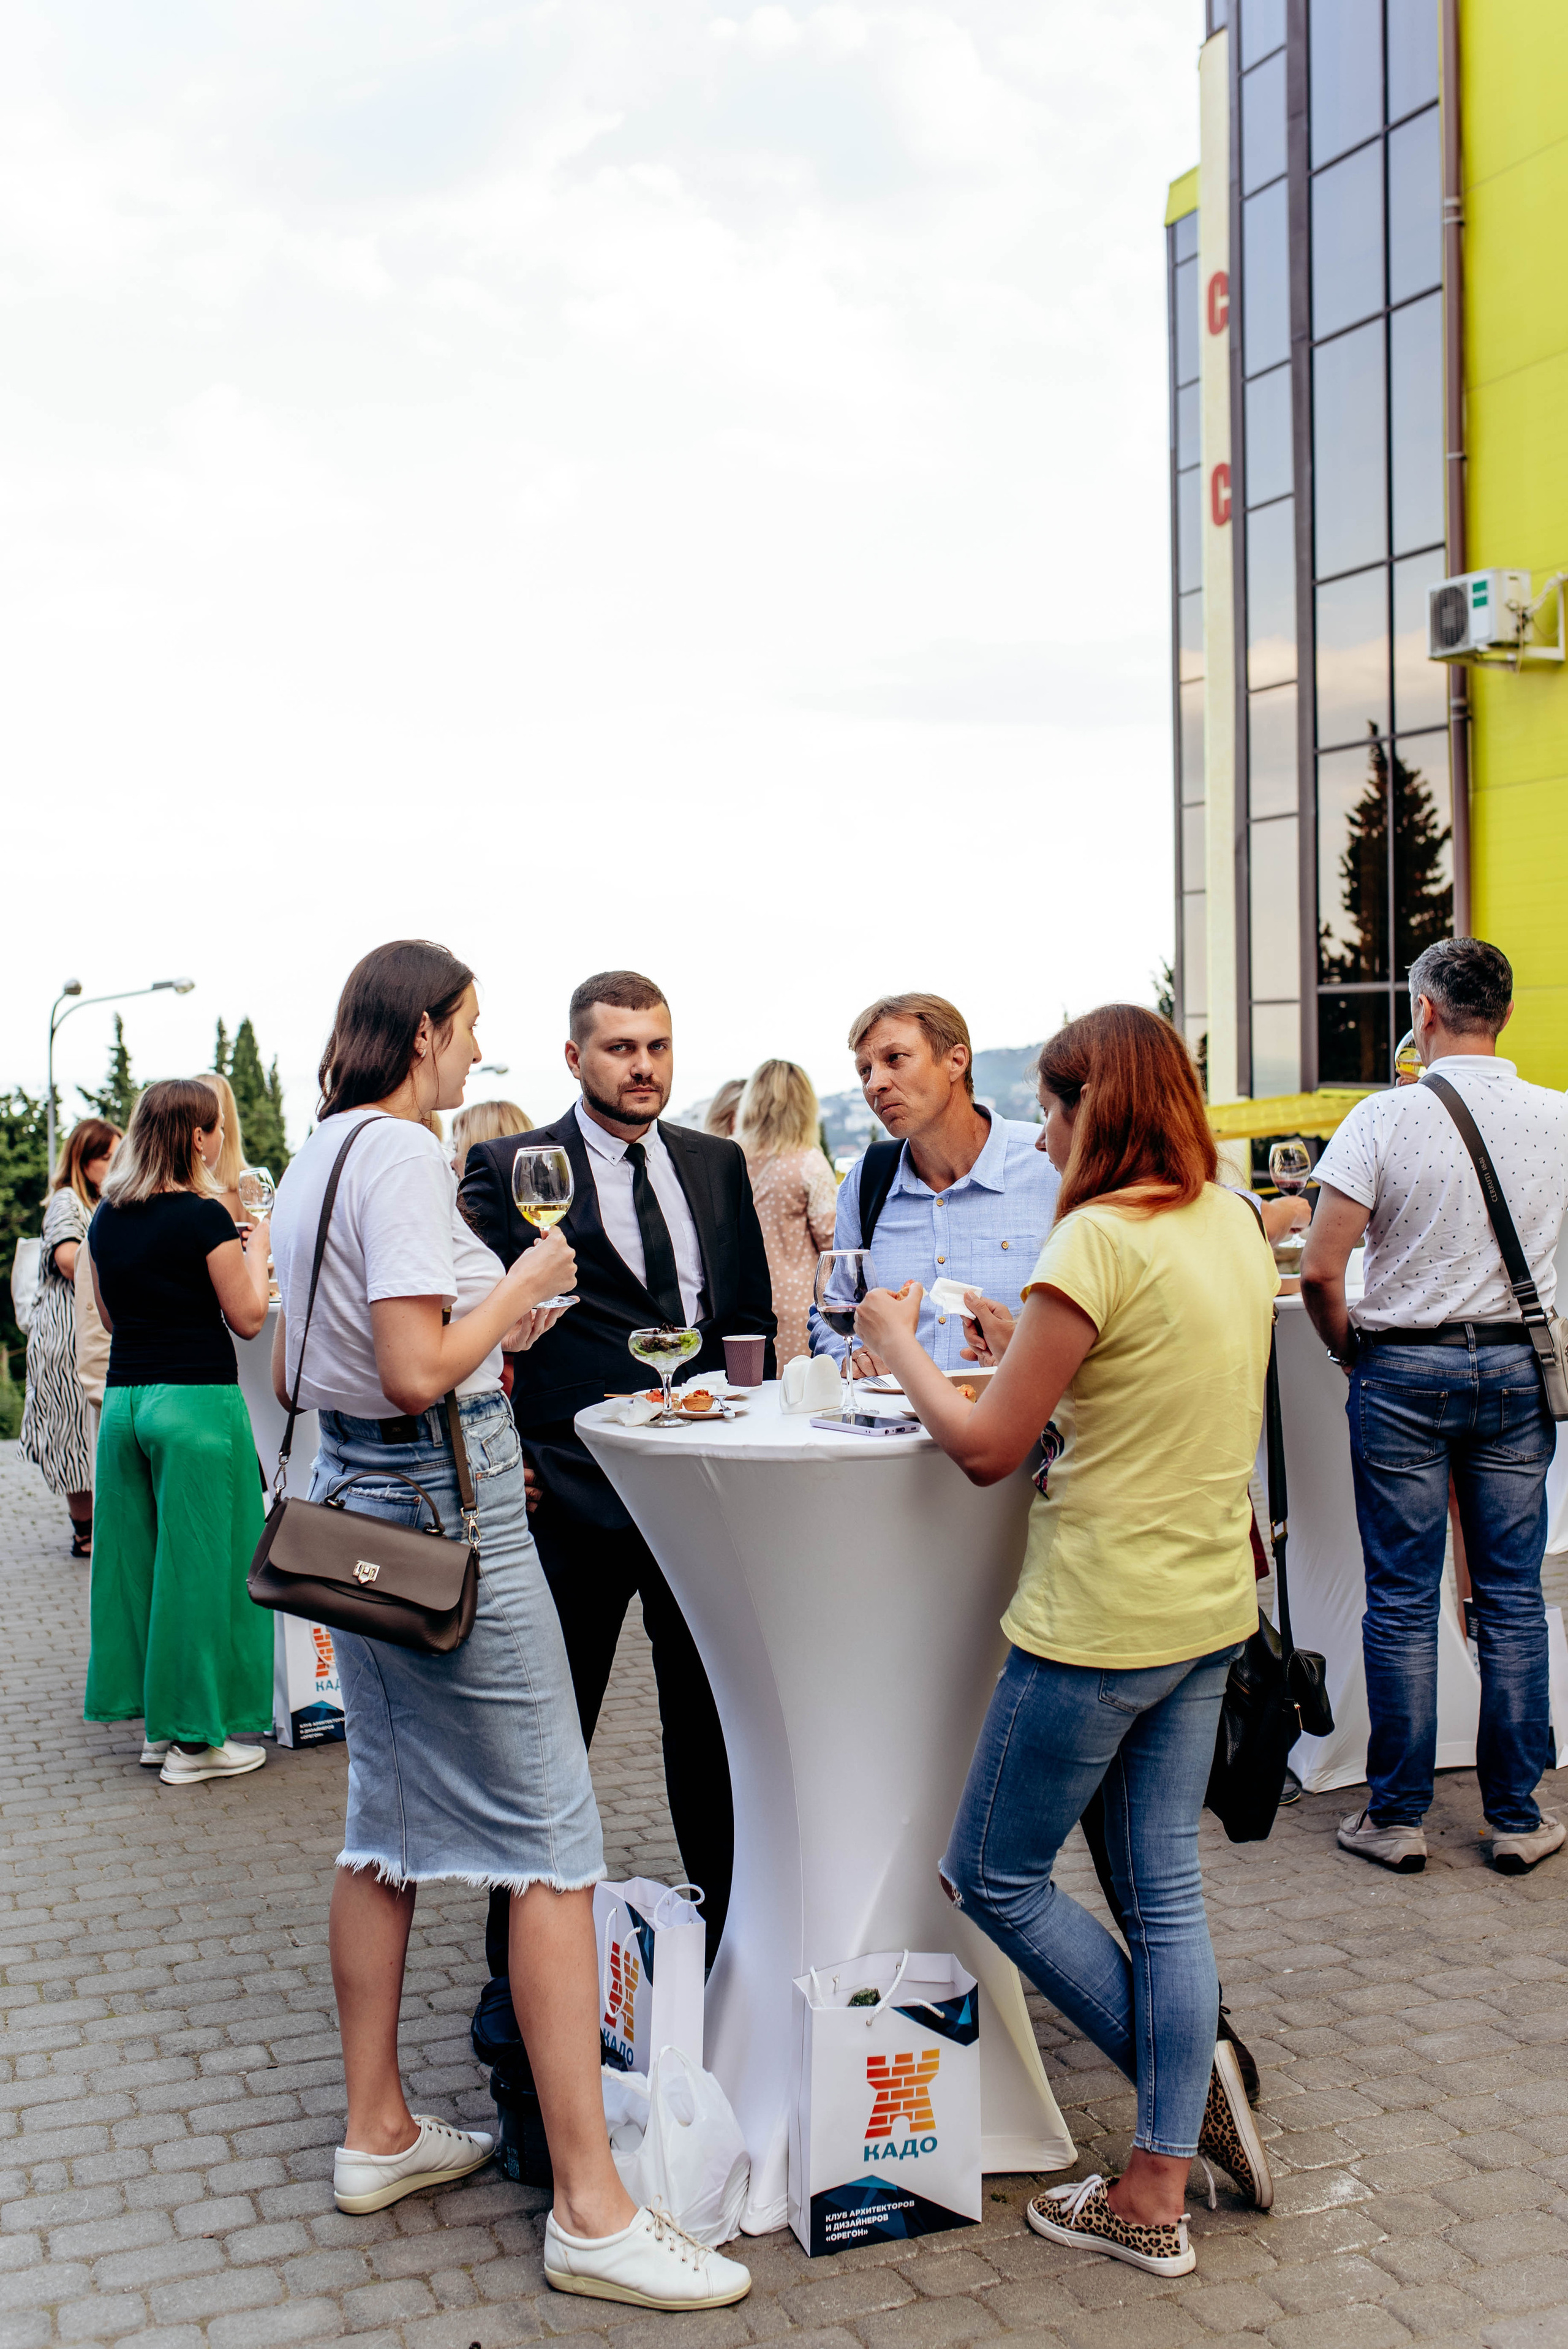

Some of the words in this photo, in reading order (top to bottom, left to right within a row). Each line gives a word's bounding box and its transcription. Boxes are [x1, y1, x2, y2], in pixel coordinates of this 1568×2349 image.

[1484, 1172, 1498, 1203] CERRUTI
[315, 1678, 341, 1692] КАД
[864, 2136, 938, 2162] КАДО
[826, 2211, 848, 2222] КЛУБ
[849, 2200, 915, 2217] АРХИТЕКТОРОВ
[833, 2213, 889, 2231] ДИЗАЙНЕРОВ
[826, 2228, 869, 2242] «ОРЕГОН»
